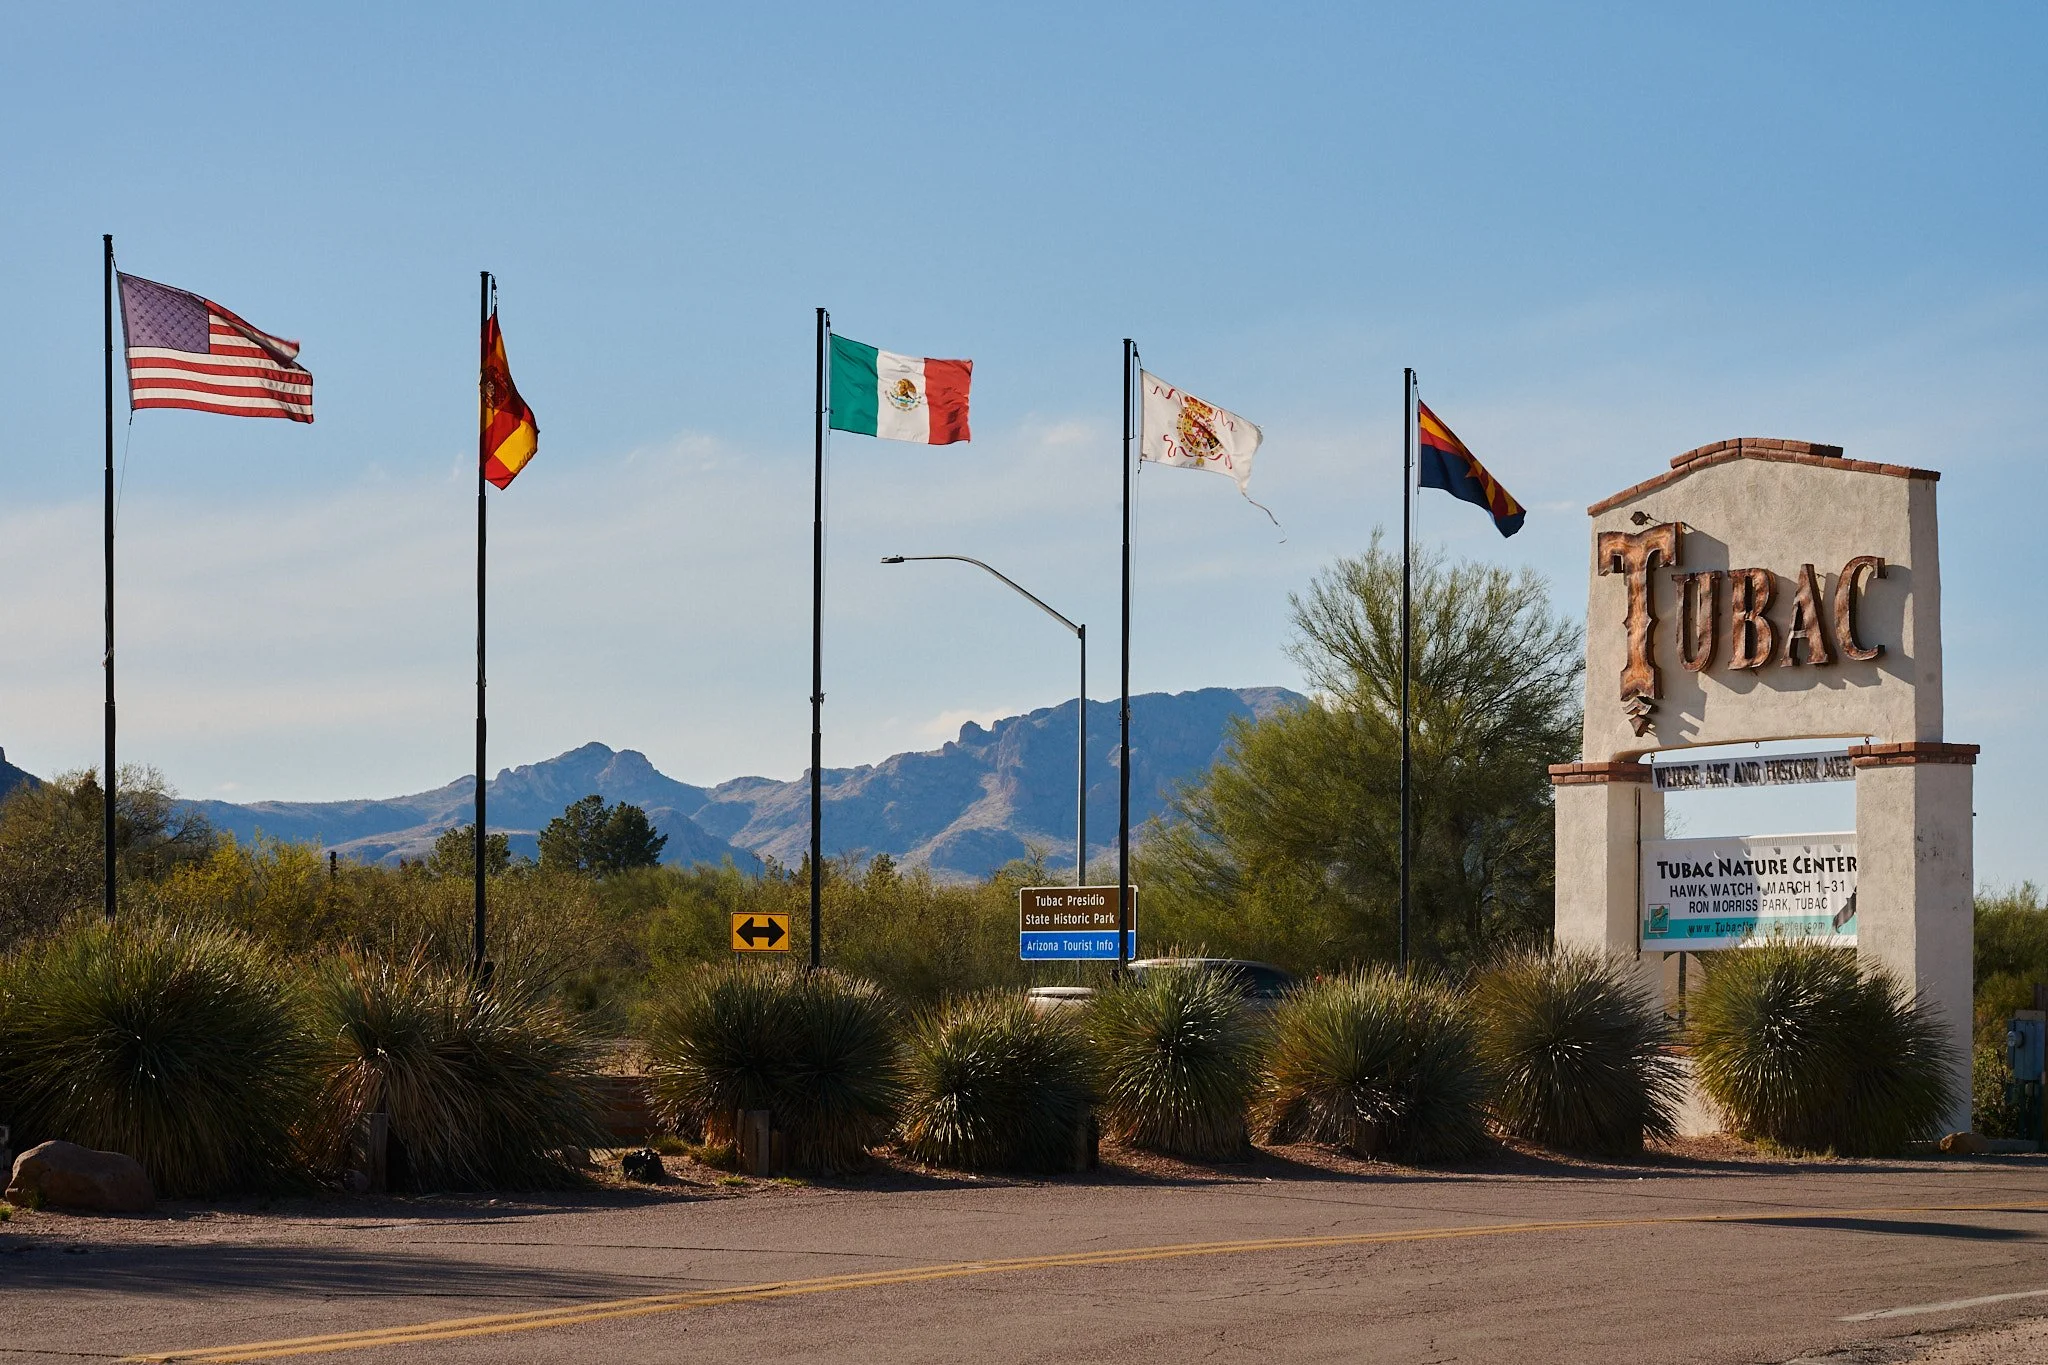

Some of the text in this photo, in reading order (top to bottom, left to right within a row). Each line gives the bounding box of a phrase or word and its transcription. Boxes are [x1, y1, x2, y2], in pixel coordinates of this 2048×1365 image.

[1598, 522, 1888, 701] TUBAC
[1654, 764, 1700, 788] WHERE
[1706, 762, 1730, 785] ART
[1734, 760, 1760, 784] AND
[1765, 757, 1819, 782] HISTORY
[1657, 860, 1714, 879] TUBAC
[1719, 858, 1788, 878] NATURE
[1670, 884, 1708, 898] HAWK
[1711, 882, 1753, 896] WATCH
[1767, 881, 1811, 895] MARCH
[1035, 894, 1105, 907] Tubac Presidio
[1689, 897, 1828, 913] RON MORRISS PARK, TUBAC
[1025, 912, 1115, 925] State Historic Park
[1027, 939, 1114, 951] Arizona Tourist Info
